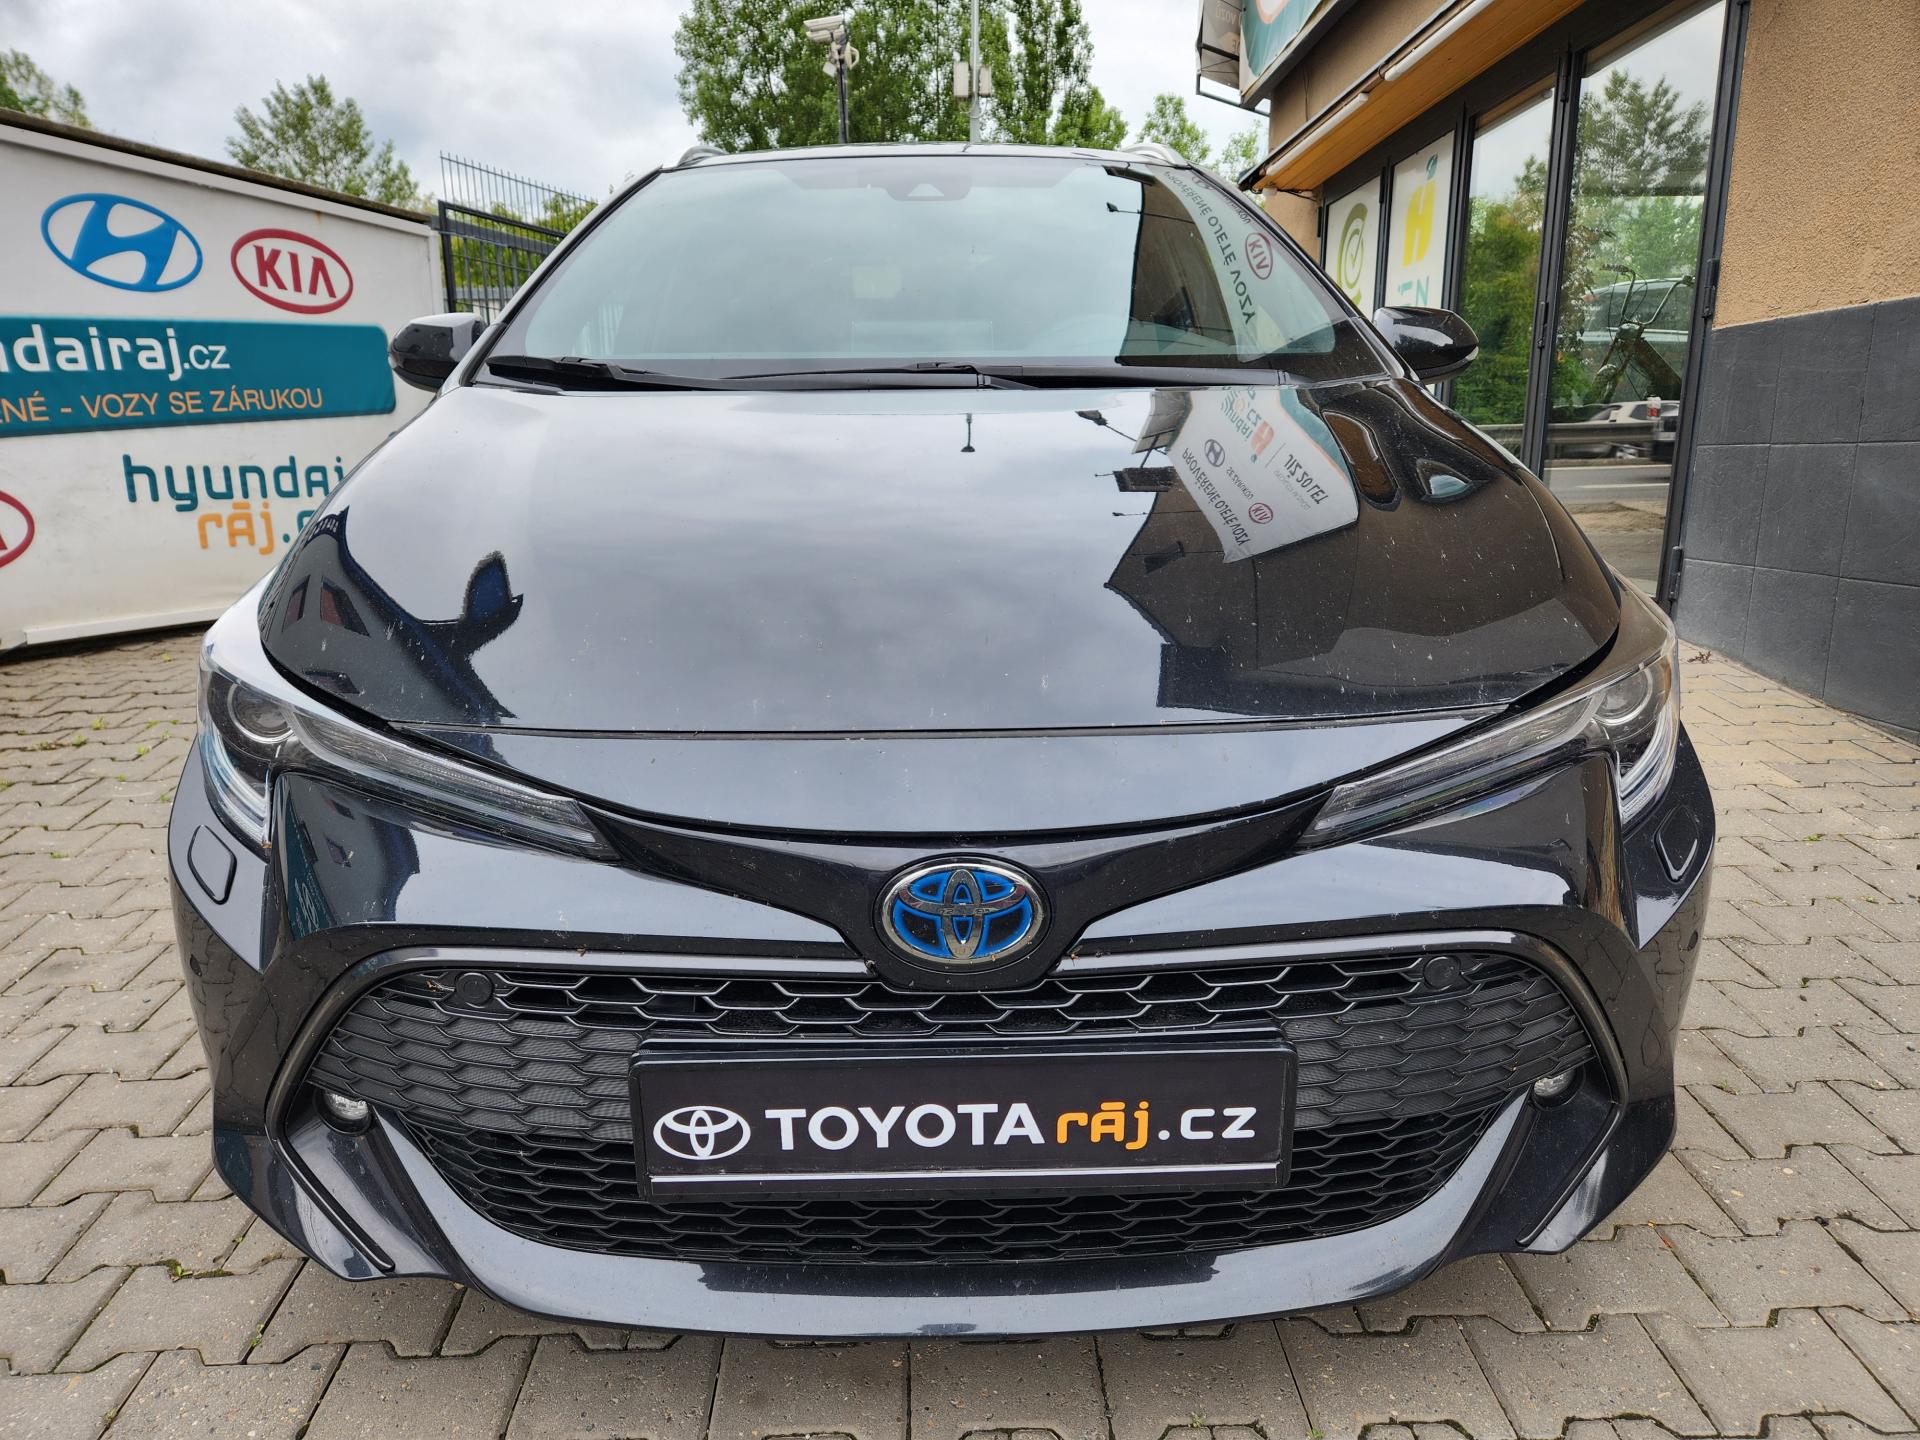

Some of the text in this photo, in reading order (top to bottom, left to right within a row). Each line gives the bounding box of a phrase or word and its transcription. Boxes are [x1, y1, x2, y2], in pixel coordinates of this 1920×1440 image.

[253, 244, 336, 299] KIA
[0, 391, 49, 424] NÉ
[80, 393, 158, 419] VOZY
[169, 391, 204, 414] SE
[210, 385, 324, 412] ZÁRUKOU
[123, 454, 345, 512] hyundai
[765, 1103, 1045, 1150] TOYOTA
